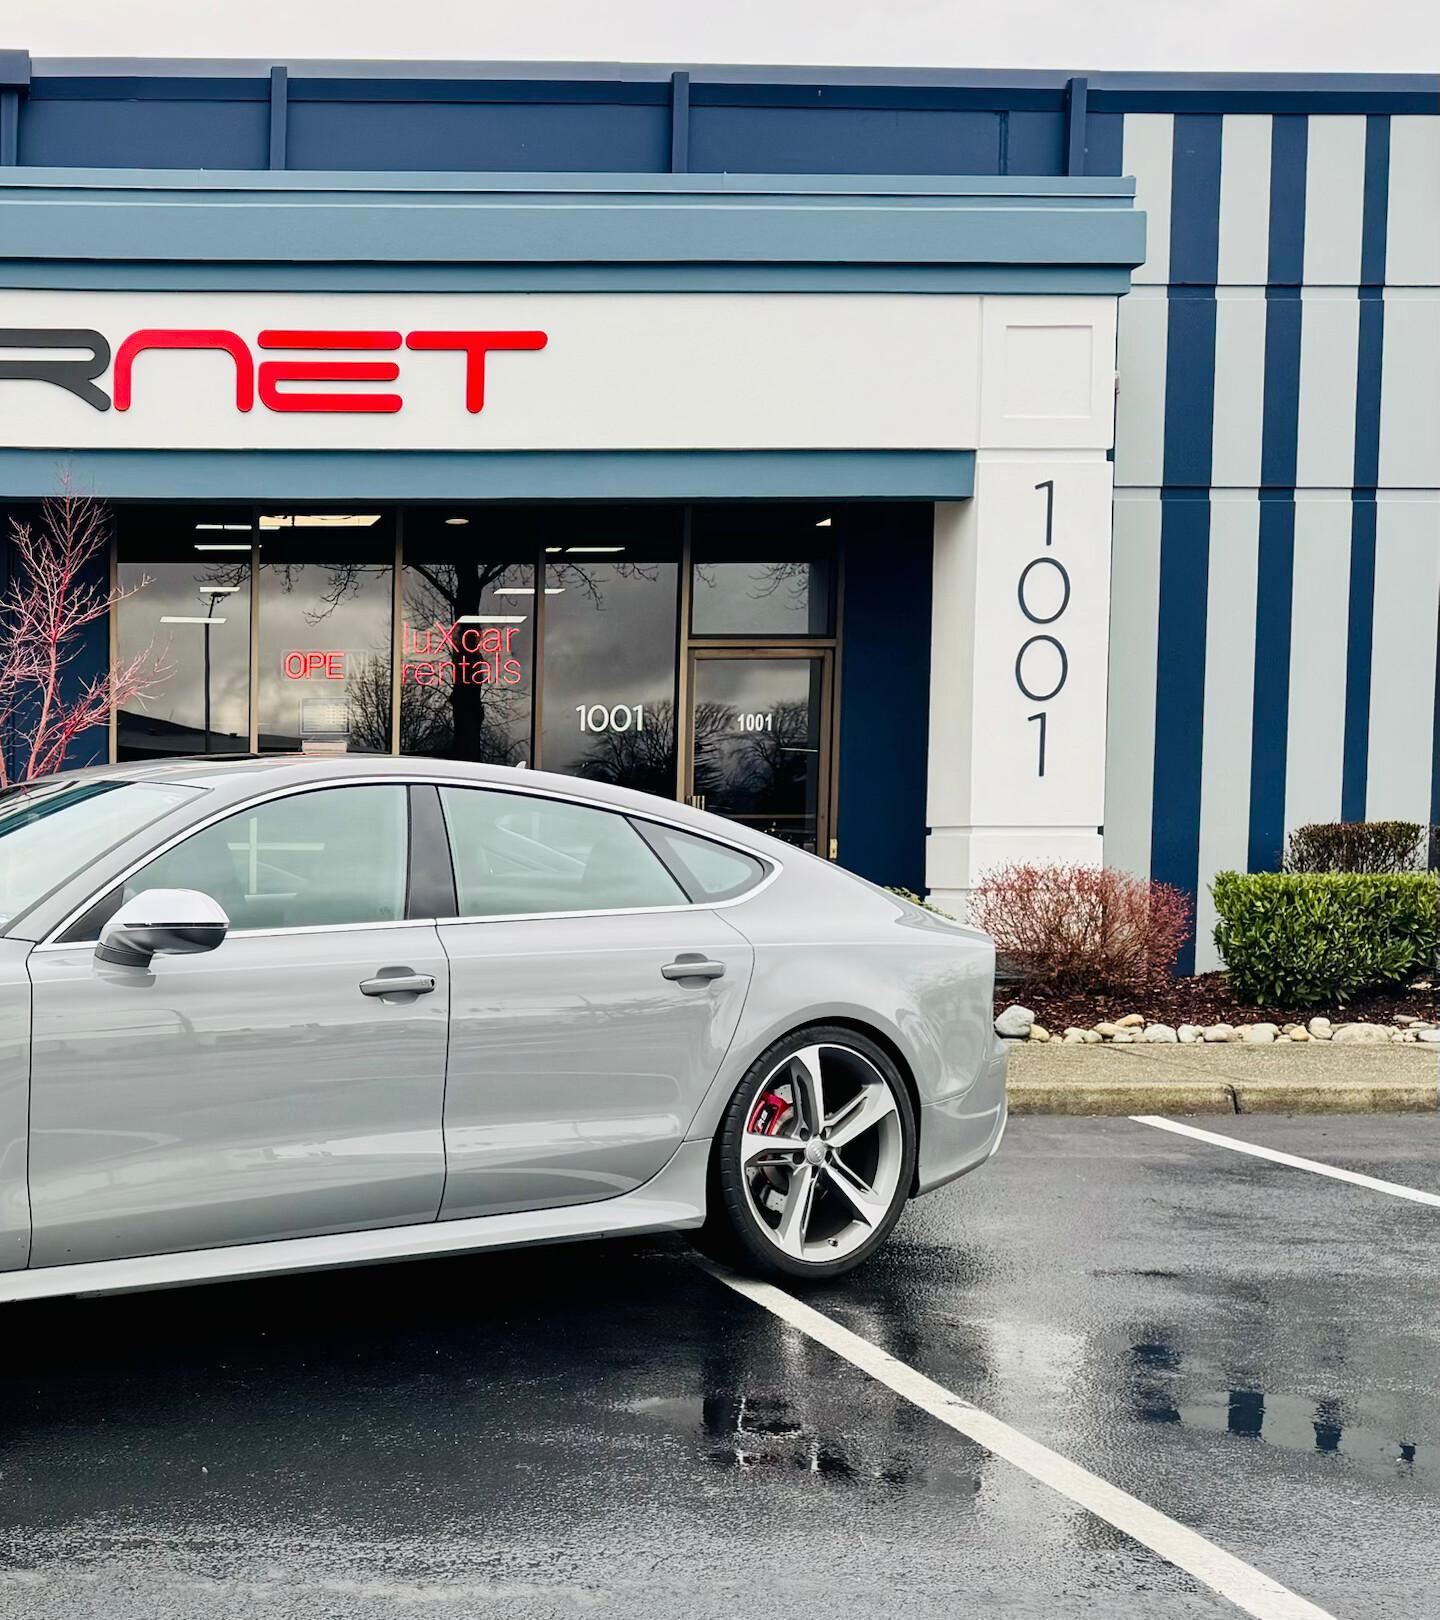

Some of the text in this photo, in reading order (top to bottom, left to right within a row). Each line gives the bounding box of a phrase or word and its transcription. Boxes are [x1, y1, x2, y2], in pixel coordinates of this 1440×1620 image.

[1015, 480, 1070, 776] 1001
[401, 652, 521, 686] rentals
[575, 704, 644, 732] 1001
[737, 713, 773, 731] 1001
